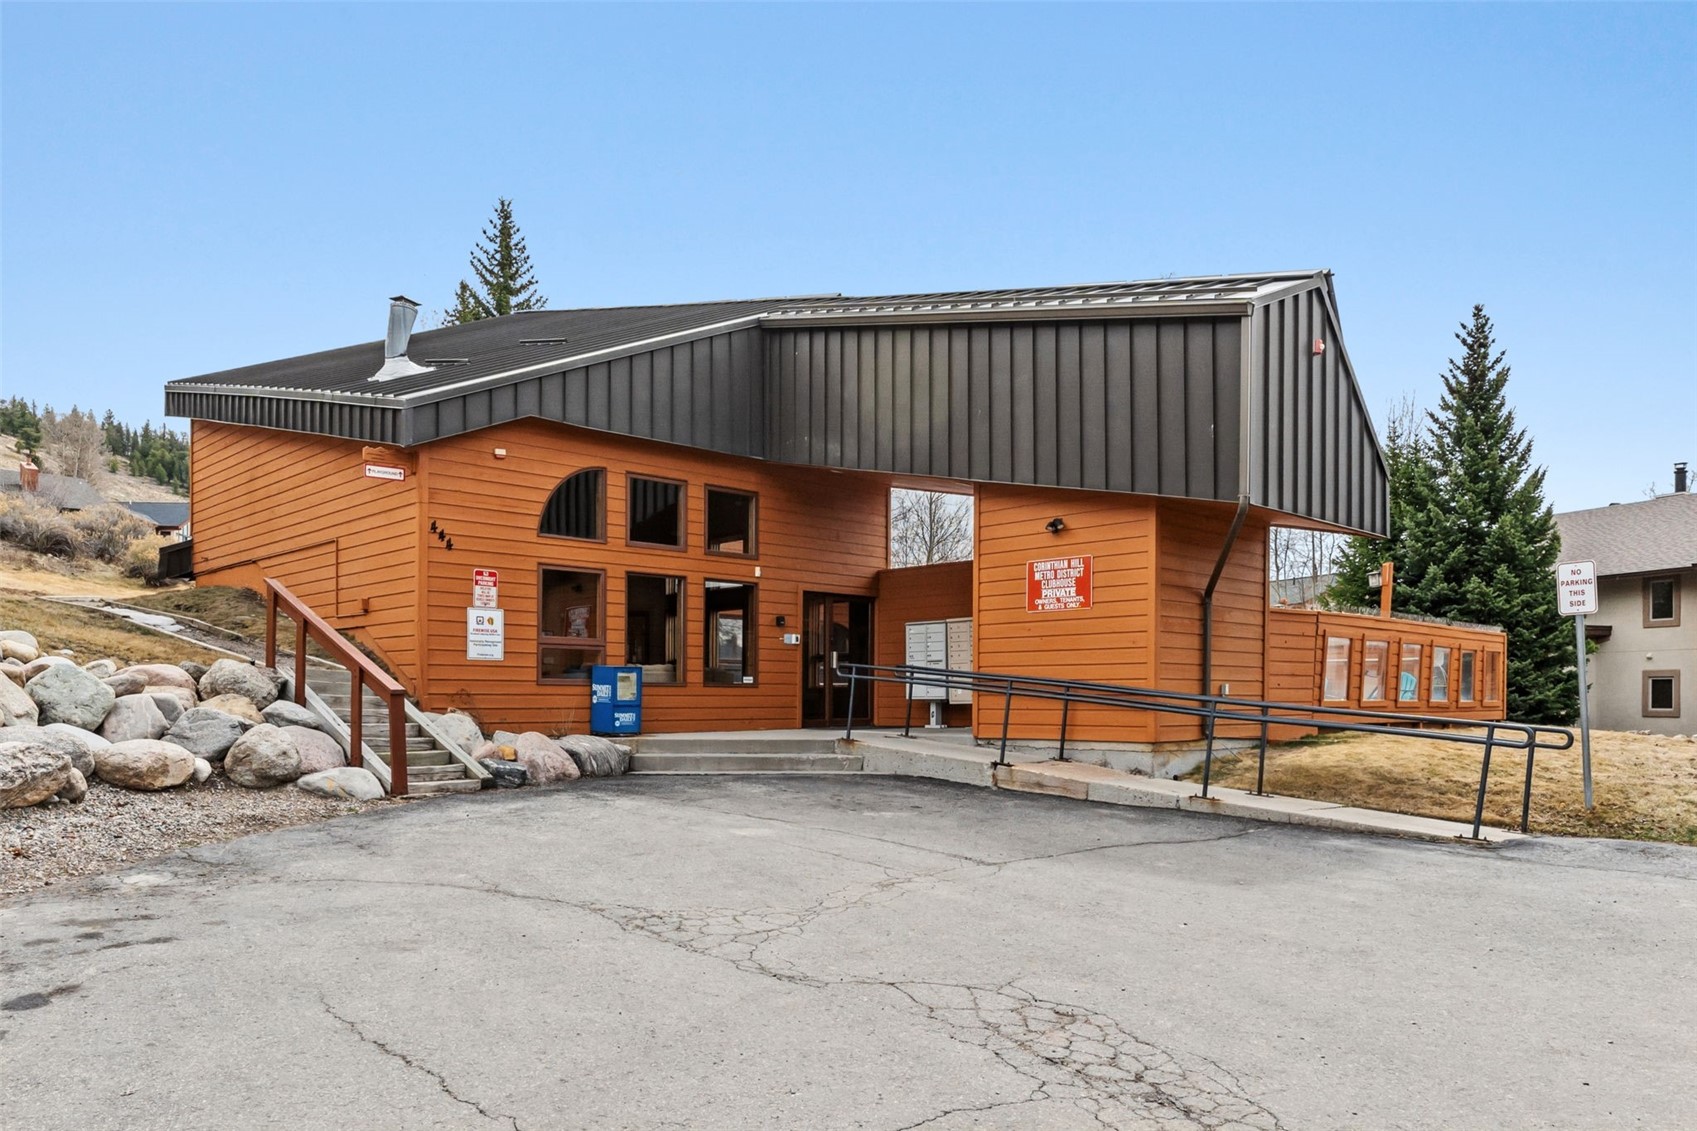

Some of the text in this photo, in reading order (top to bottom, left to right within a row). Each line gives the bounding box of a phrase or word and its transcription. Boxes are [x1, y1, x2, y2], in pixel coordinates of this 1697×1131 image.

[430, 520, 454, 551] 444
[1033, 558, 1084, 572] CORINTHIAN HILL
[1034, 567, 1084, 581] METRO DISTRICT
[1570, 568, 1582, 576] NO
[1041, 577, 1076, 589] CLUBHOUSE
[1560, 578, 1593, 587] PARKING
[1042, 587, 1076, 598] PRIVATE
[1569, 589, 1586, 597] THIS
[1044, 602, 1065, 610] GUESTS
[1569, 600, 1586, 608] SIDE
